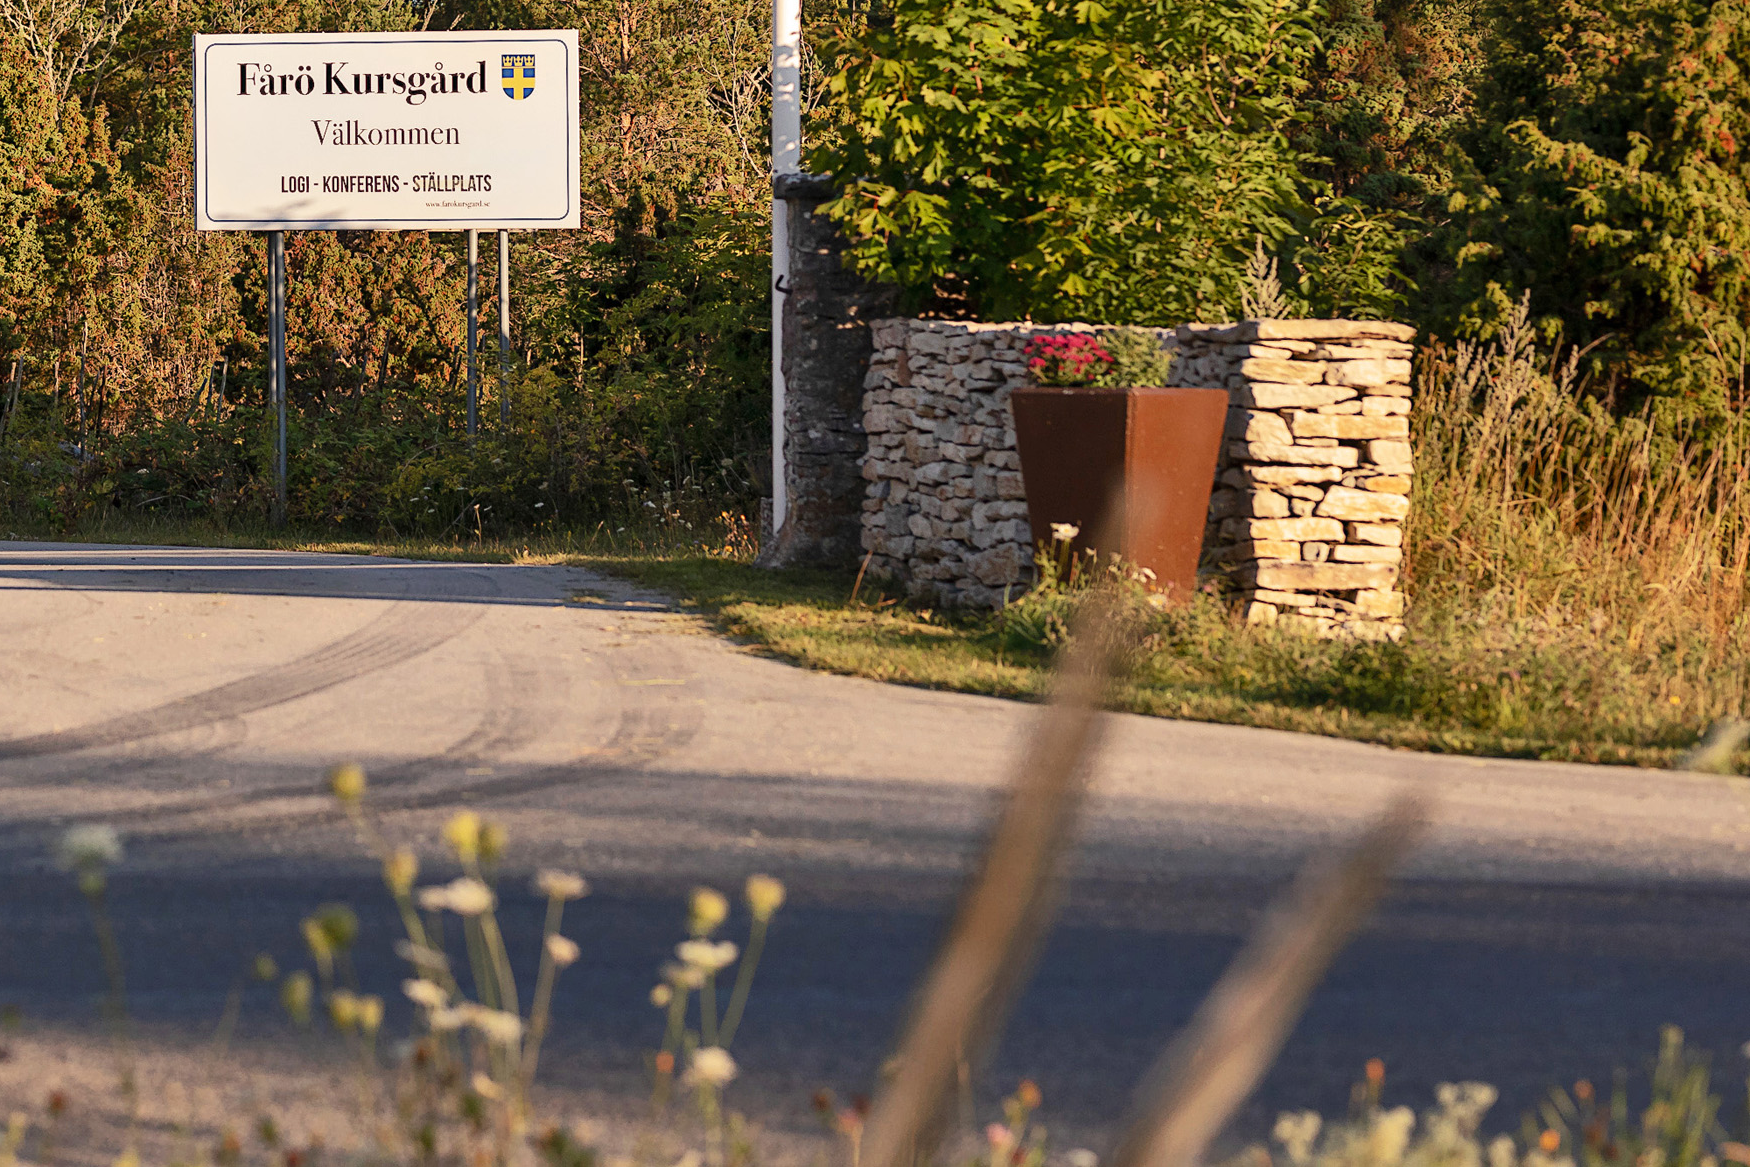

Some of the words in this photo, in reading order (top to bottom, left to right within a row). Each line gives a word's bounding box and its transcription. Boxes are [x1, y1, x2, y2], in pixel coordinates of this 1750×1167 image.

[236, 62, 315, 96] Fårö
[322, 60, 488, 106] Kursgård
[310, 119, 460, 146] Välkommen
[281, 175, 310, 194] LOGI
[322, 174, 400, 193] KONFERENS
[412, 171, 492, 193] STÄLLPLATS
